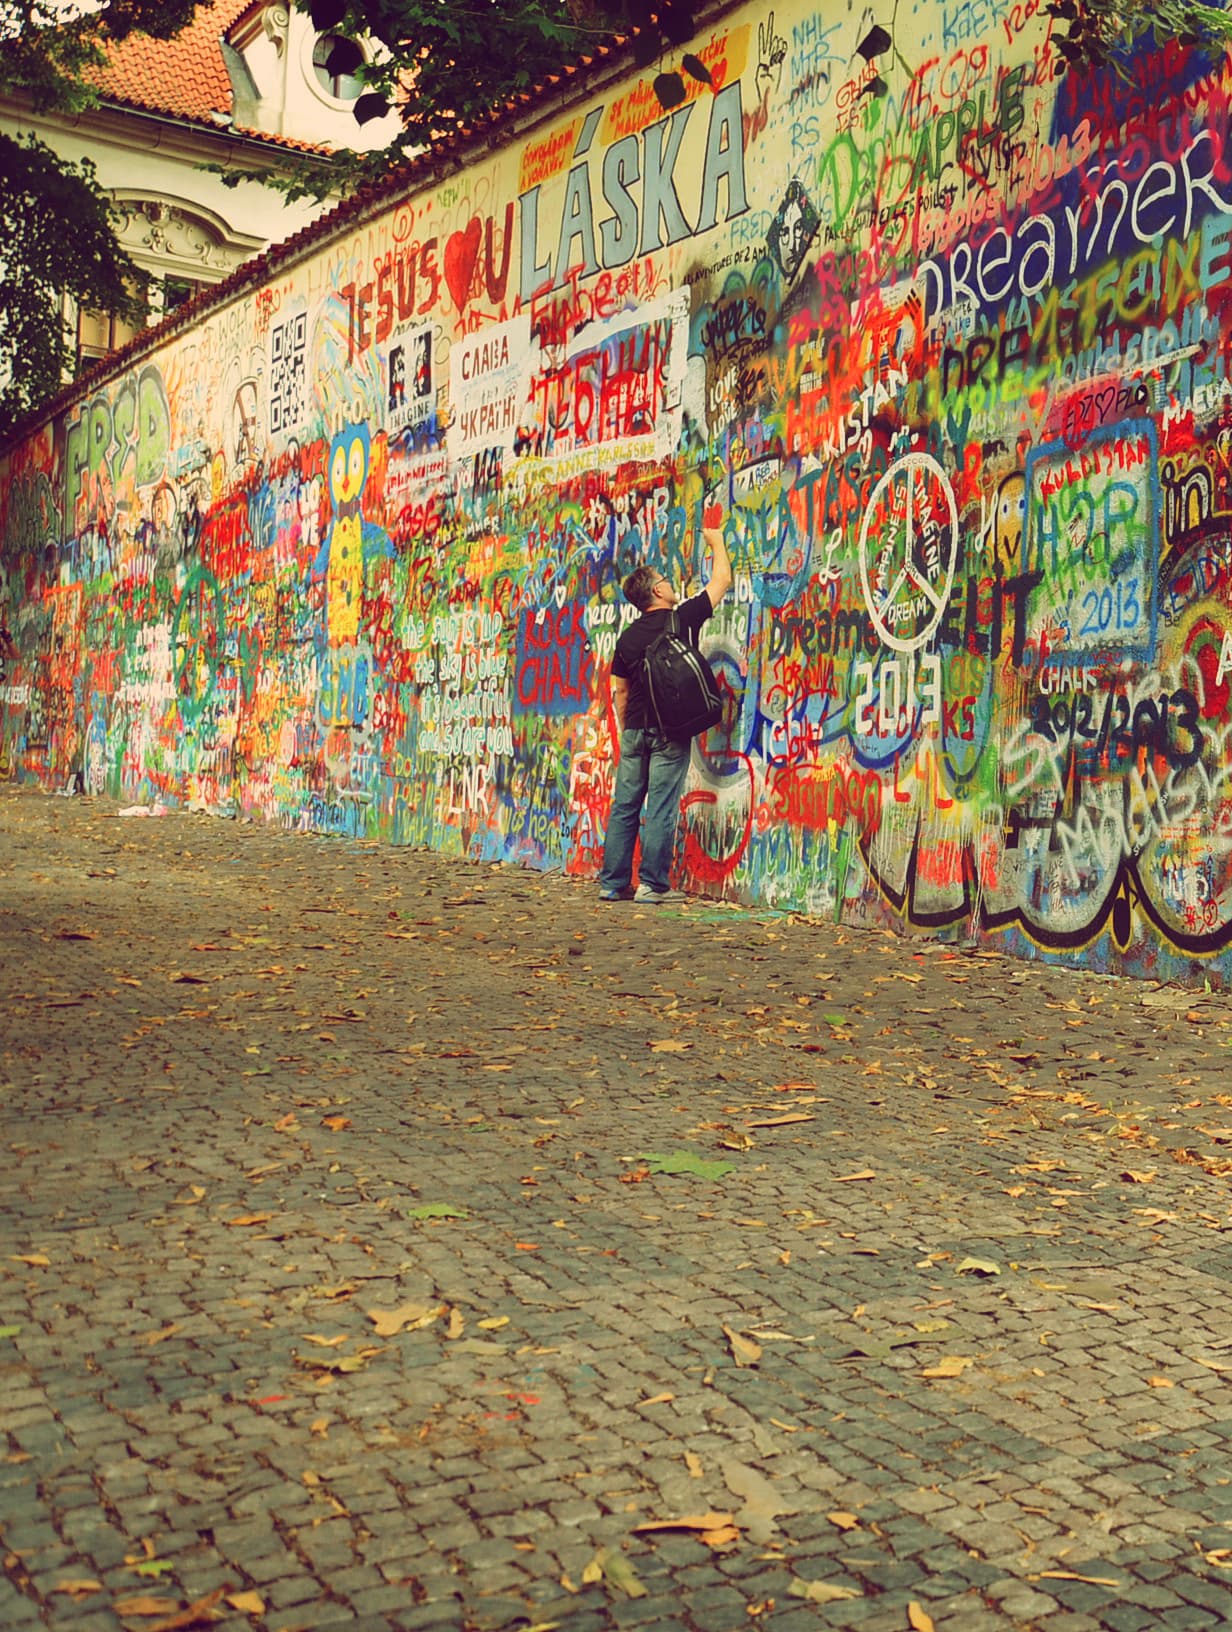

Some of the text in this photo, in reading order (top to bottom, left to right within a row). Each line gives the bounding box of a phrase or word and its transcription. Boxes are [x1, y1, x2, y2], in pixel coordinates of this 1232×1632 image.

[912, 64, 1026, 193] APPLE
[519, 80, 752, 306] LÁSKA
[390, 402, 432, 429] IMAGINE
[914, 482, 941, 581] IMAGINE
[524, 601, 588, 650] ROCK
[888, 596, 929, 625] DREAM
[1080, 577, 1141, 636] 2013
[517, 651, 595, 706] CHALK
[855, 654, 943, 735] 2013
